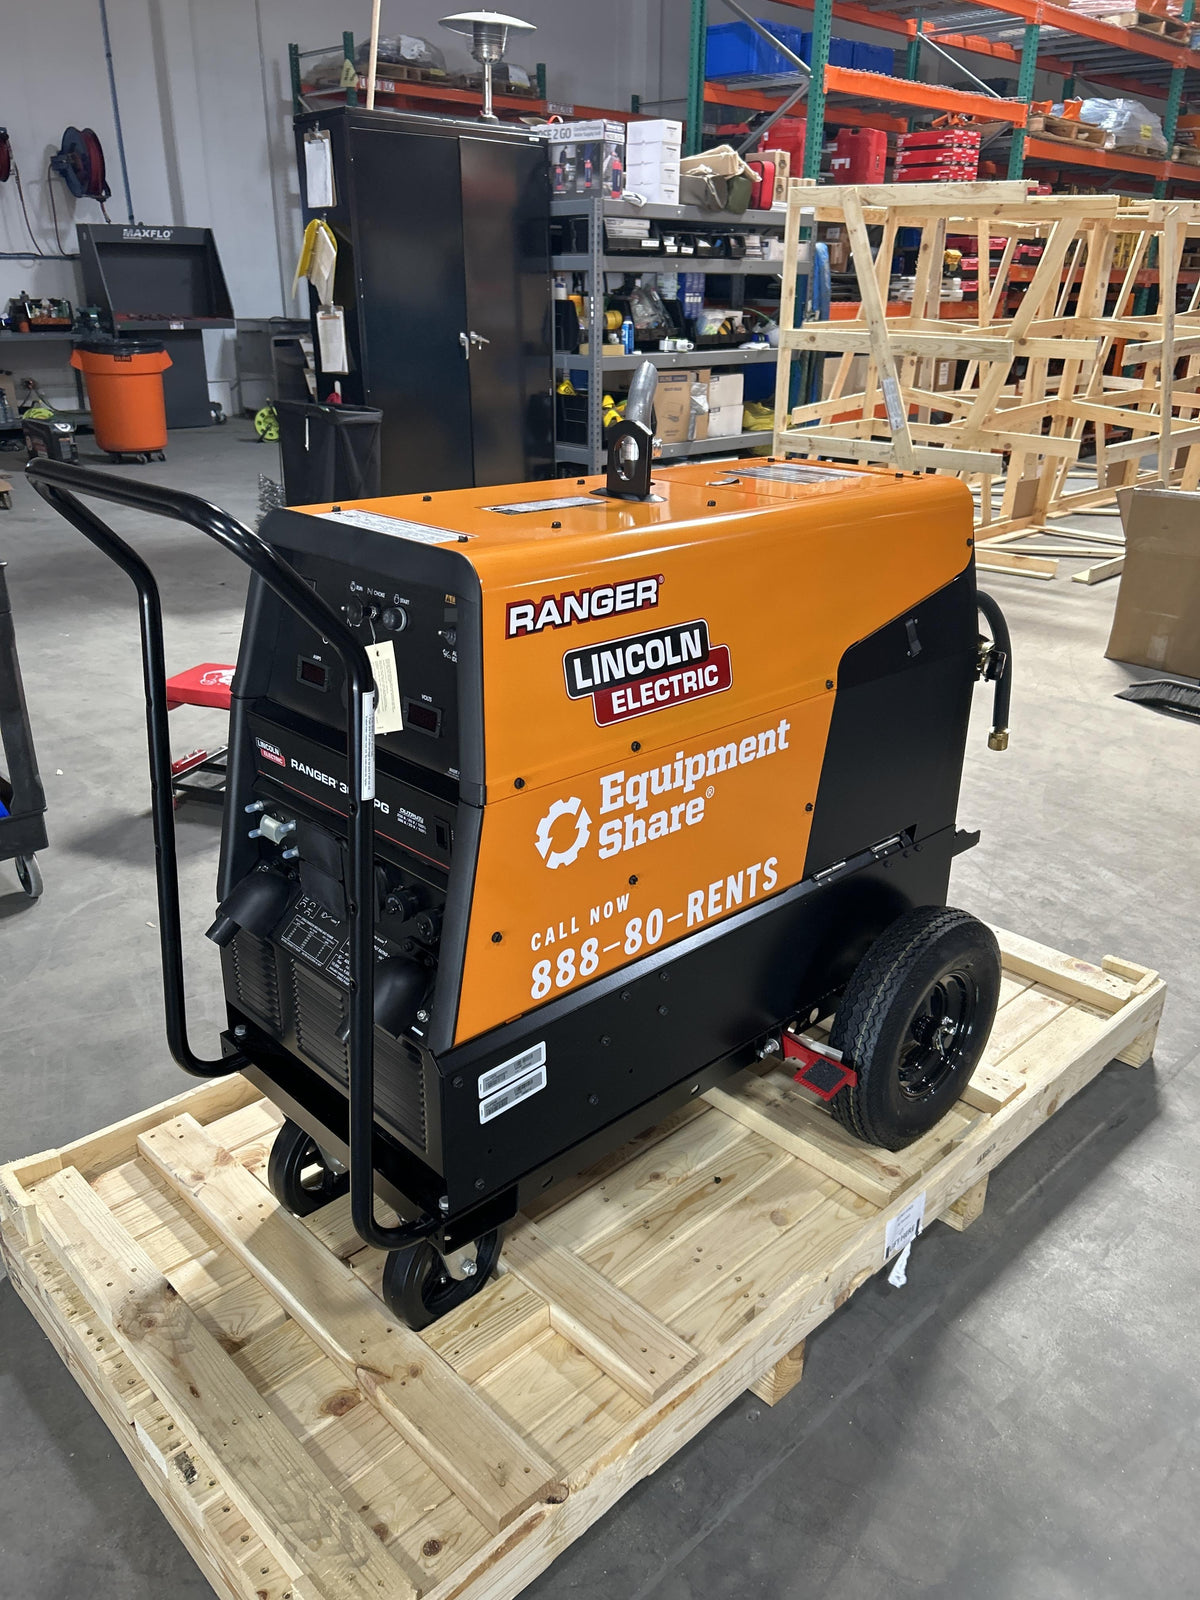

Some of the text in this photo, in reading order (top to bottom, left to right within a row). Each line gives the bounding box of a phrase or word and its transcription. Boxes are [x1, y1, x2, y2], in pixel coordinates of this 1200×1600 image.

[560, 127, 571, 139] GO
[123, 229, 171, 238] MAXFLO
[508, 577, 659, 636] RANGER
[573, 628, 702, 690] LINCOLN
[611, 664, 719, 715] ELECTRIC
[257, 739, 280, 755] LINCOLN
[263, 750, 283, 764] ELECTRIC
[291, 758, 337, 789] RANGER
[599, 719, 790, 815] Equipment
[598, 796, 705, 860] Share
[530, 856, 778, 1000] 888-80-RENTS
[531, 893, 630, 951] CALL NOW
